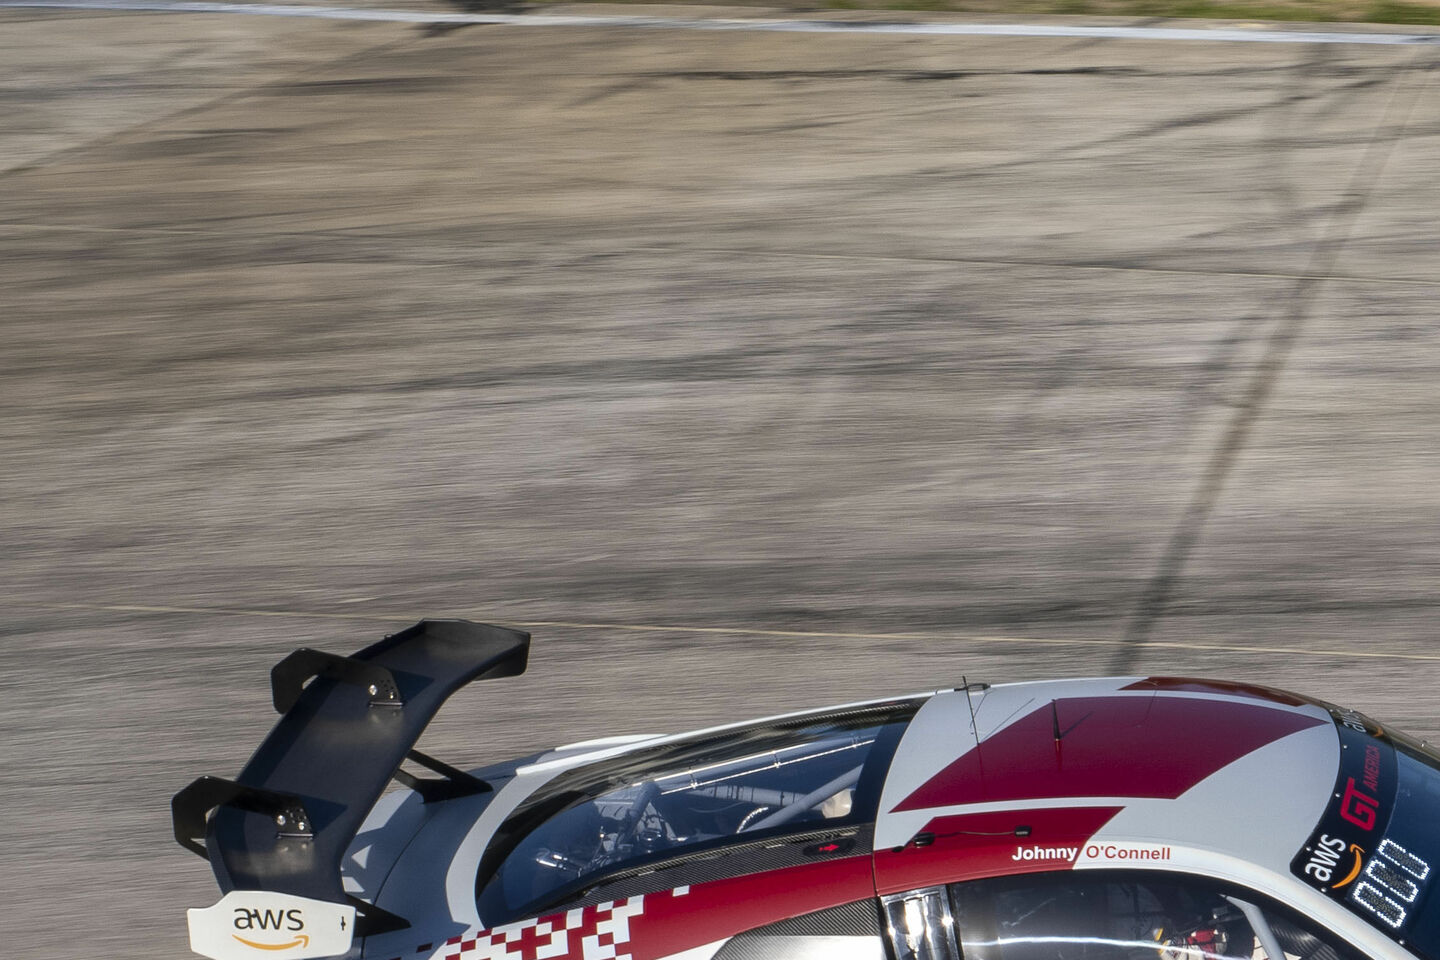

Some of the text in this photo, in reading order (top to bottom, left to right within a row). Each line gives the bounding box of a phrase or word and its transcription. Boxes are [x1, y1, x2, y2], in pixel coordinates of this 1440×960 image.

[1340, 776, 1380, 832] GT
[1012, 845, 1171, 861] Johnny O'Connell
[1304, 834, 1348, 883] aws
[233, 907, 305, 932] aws
